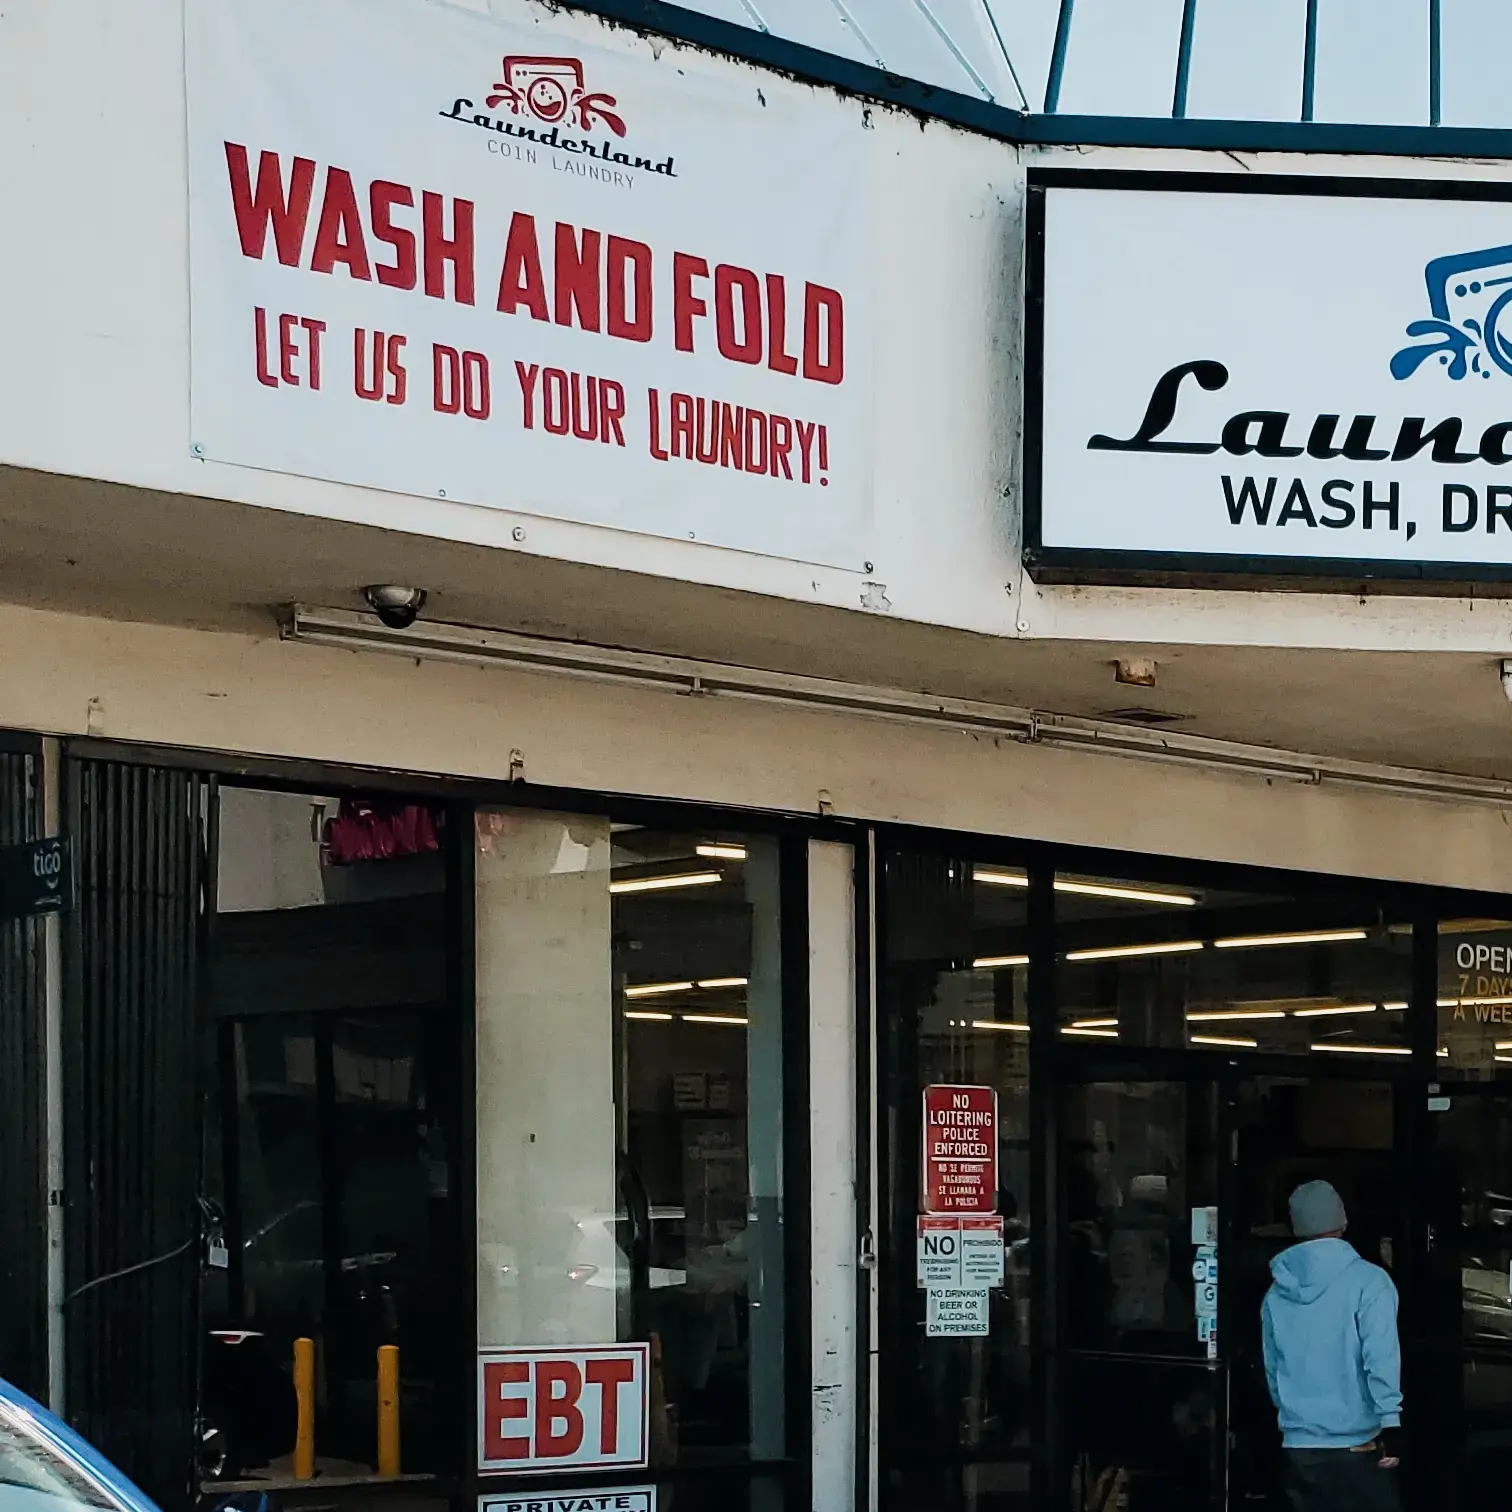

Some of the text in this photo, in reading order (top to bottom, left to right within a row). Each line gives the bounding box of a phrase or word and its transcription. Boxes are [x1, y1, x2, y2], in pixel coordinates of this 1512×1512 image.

[438, 98, 679, 179] Launderland
[486, 139, 636, 190] COIN LAUNDRY
[223, 140, 846, 387] WASH AND FOLD
[253, 305, 830, 488] LET US DO YOUR LAUNDRY!
[1220, 473, 1418, 544] WASH,
[1459, 976, 1469, 997] 7
[1454, 1001, 1465, 1021] A
[953, 1094, 969, 1109] NO
[930, 1111, 992, 1127] LOITERING
[943, 1128, 979, 1141] POLICE
[934, 1142, 988, 1156] ENFORCED
[924, 1236, 955, 1256] NO
[930, 1289, 987, 1299] NO DRINKING
[939, 1301, 978, 1310] BEER OR
[937, 1312, 979, 1322] ALCOHOL
[928, 1323, 988, 1333] ON PREMISES
[484, 1358, 634, 1461] EBT
